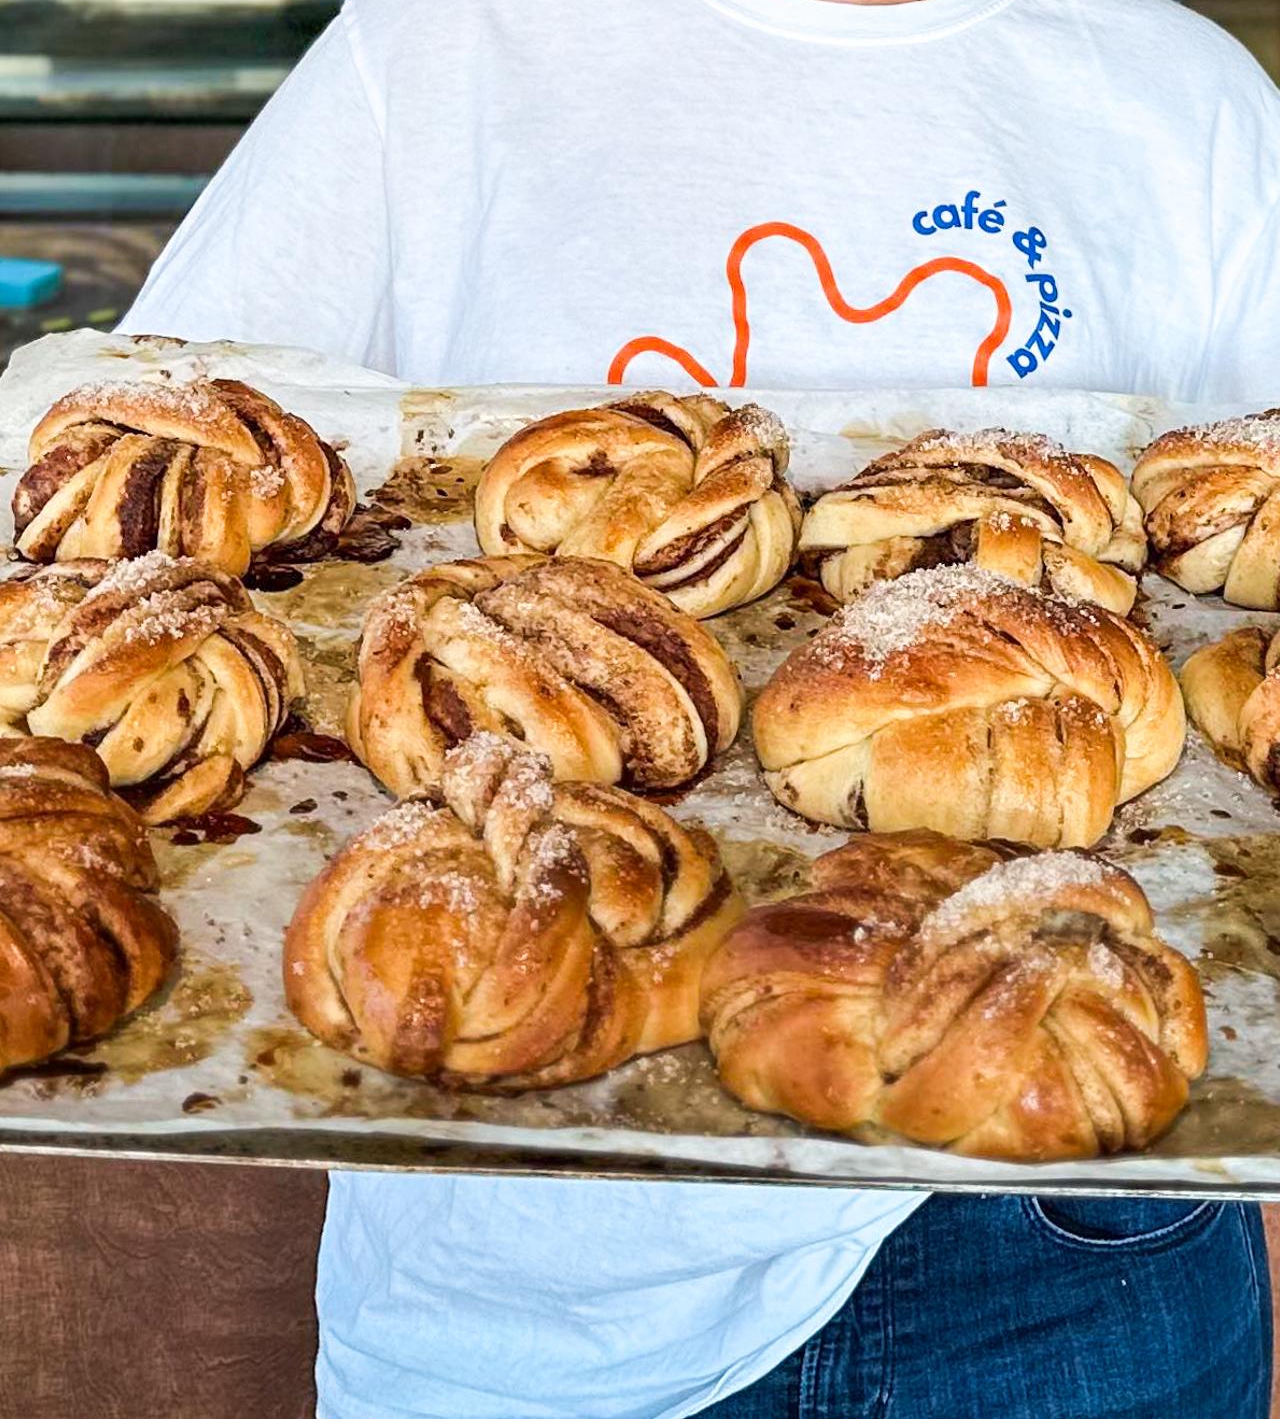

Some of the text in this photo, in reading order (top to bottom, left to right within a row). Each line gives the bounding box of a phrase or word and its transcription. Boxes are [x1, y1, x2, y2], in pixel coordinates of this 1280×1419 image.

[912, 190, 1073, 379] café & pizza
